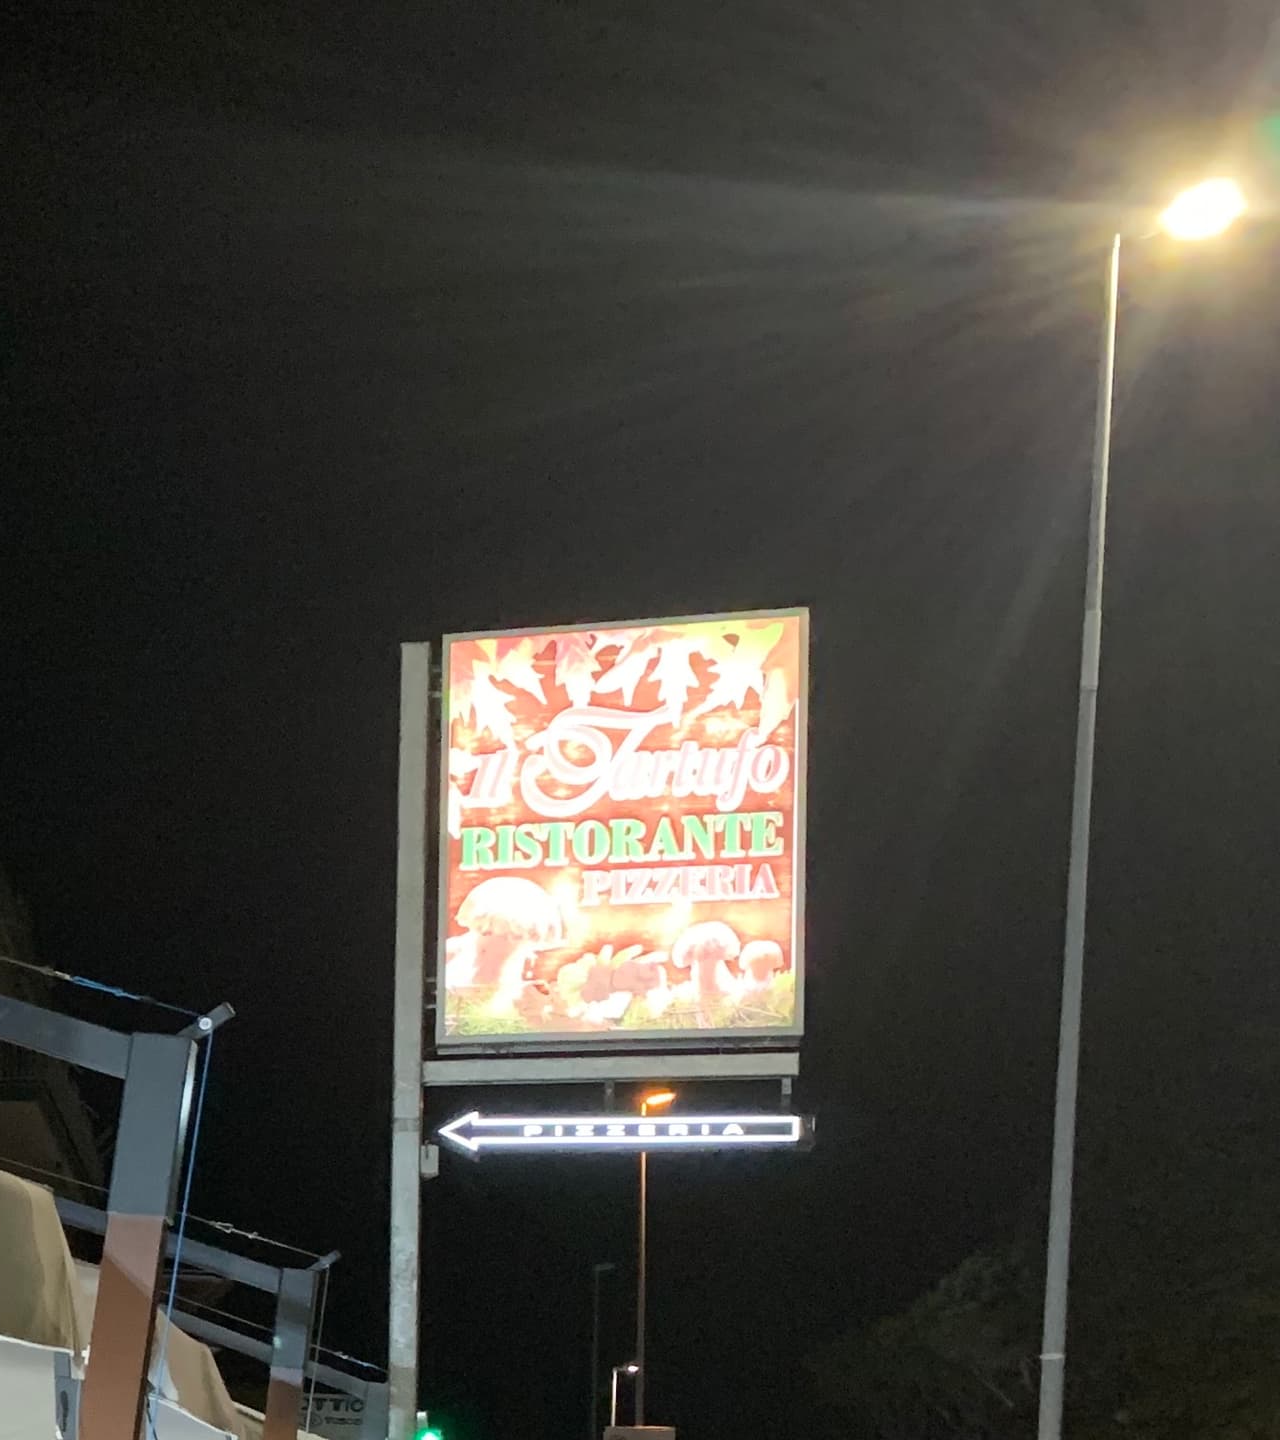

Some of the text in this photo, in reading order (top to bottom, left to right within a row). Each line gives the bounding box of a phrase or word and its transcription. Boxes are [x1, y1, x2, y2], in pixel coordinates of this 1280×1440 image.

[520, 706, 789, 817] Tartufo
[460, 811, 784, 871] RISTORANTE
[581, 862, 780, 906] PIZZERIA
[523, 1123, 744, 1137] PIZZERIA
